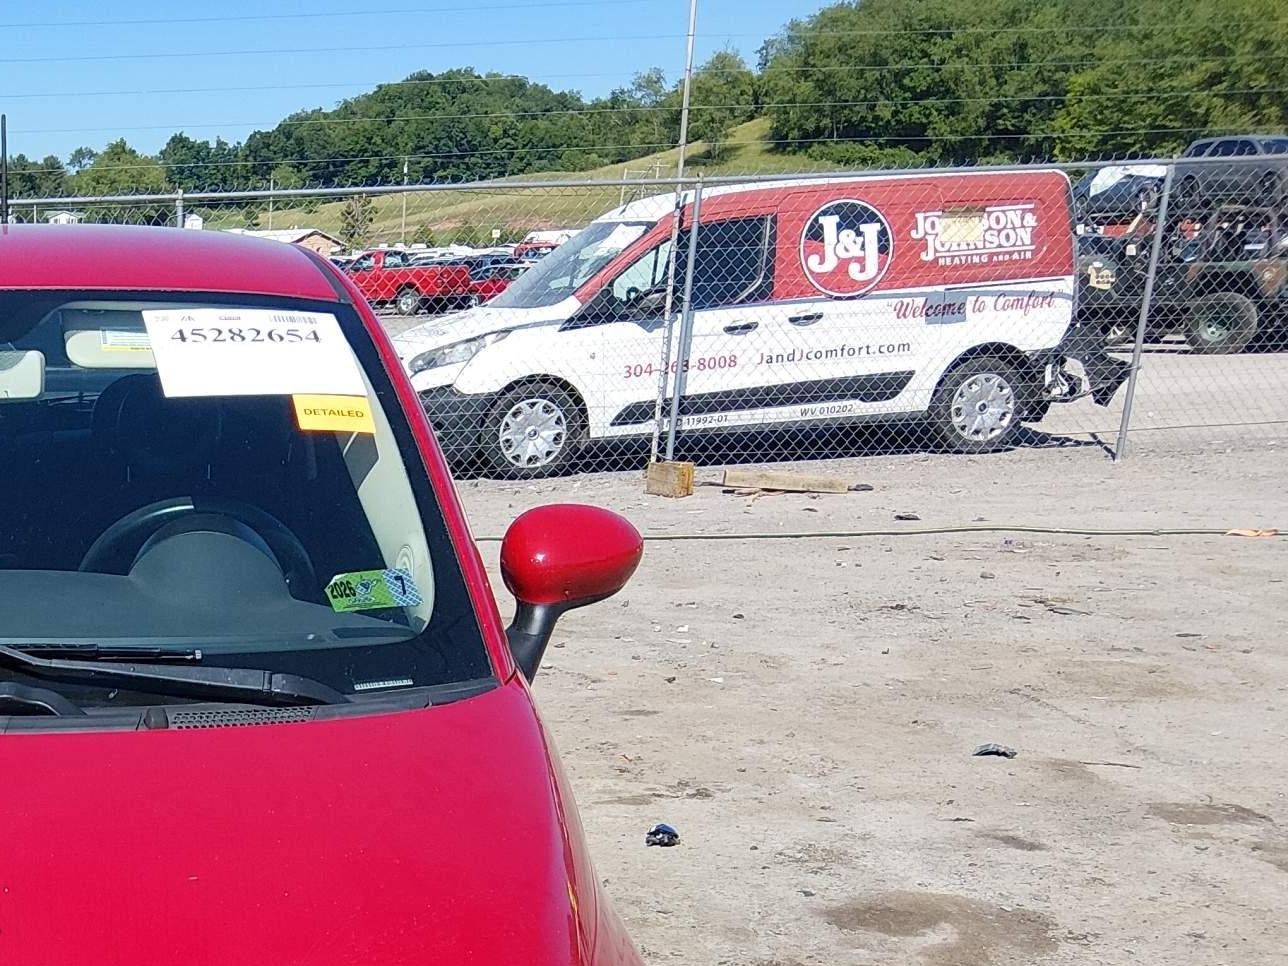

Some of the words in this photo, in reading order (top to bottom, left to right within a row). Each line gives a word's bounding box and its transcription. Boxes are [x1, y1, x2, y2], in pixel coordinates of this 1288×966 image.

[910, 210, 1038, 239] JOON&
[807, 215, 881, 281] J&J
[938, 254, 989, 266] HEATING
[1012, 251, 1032, 260] AIR
[972, 299, 986, 314] to
[170, 327, 321, 343] 45282654
[757, 342, 912, 366] JandJcomfort.com
[303, 408, 364, 419] DETAILED
[800, 408, 818, 417] WV
[819, 404, 854, 416] 010202
[328, 580, 357, 600] 2026
[394, 575, 407, 596] 7
